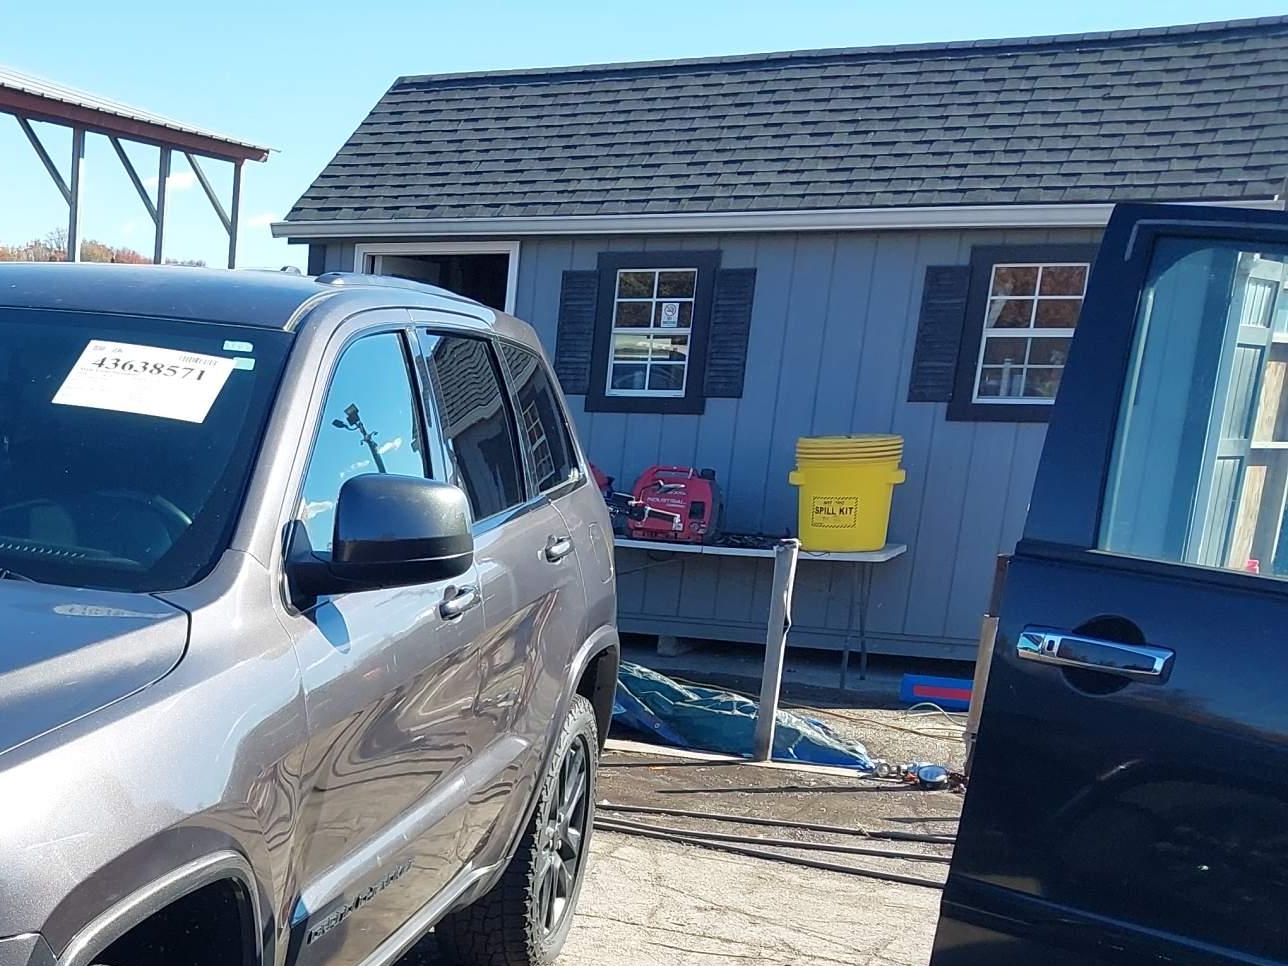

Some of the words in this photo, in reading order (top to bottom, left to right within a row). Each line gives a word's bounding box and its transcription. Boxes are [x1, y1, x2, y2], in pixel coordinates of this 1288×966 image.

[91, 356, 206, 381] 43638571
[815, 506, 837, 515] SPILL
[839, 506, 853, 515] KIT
